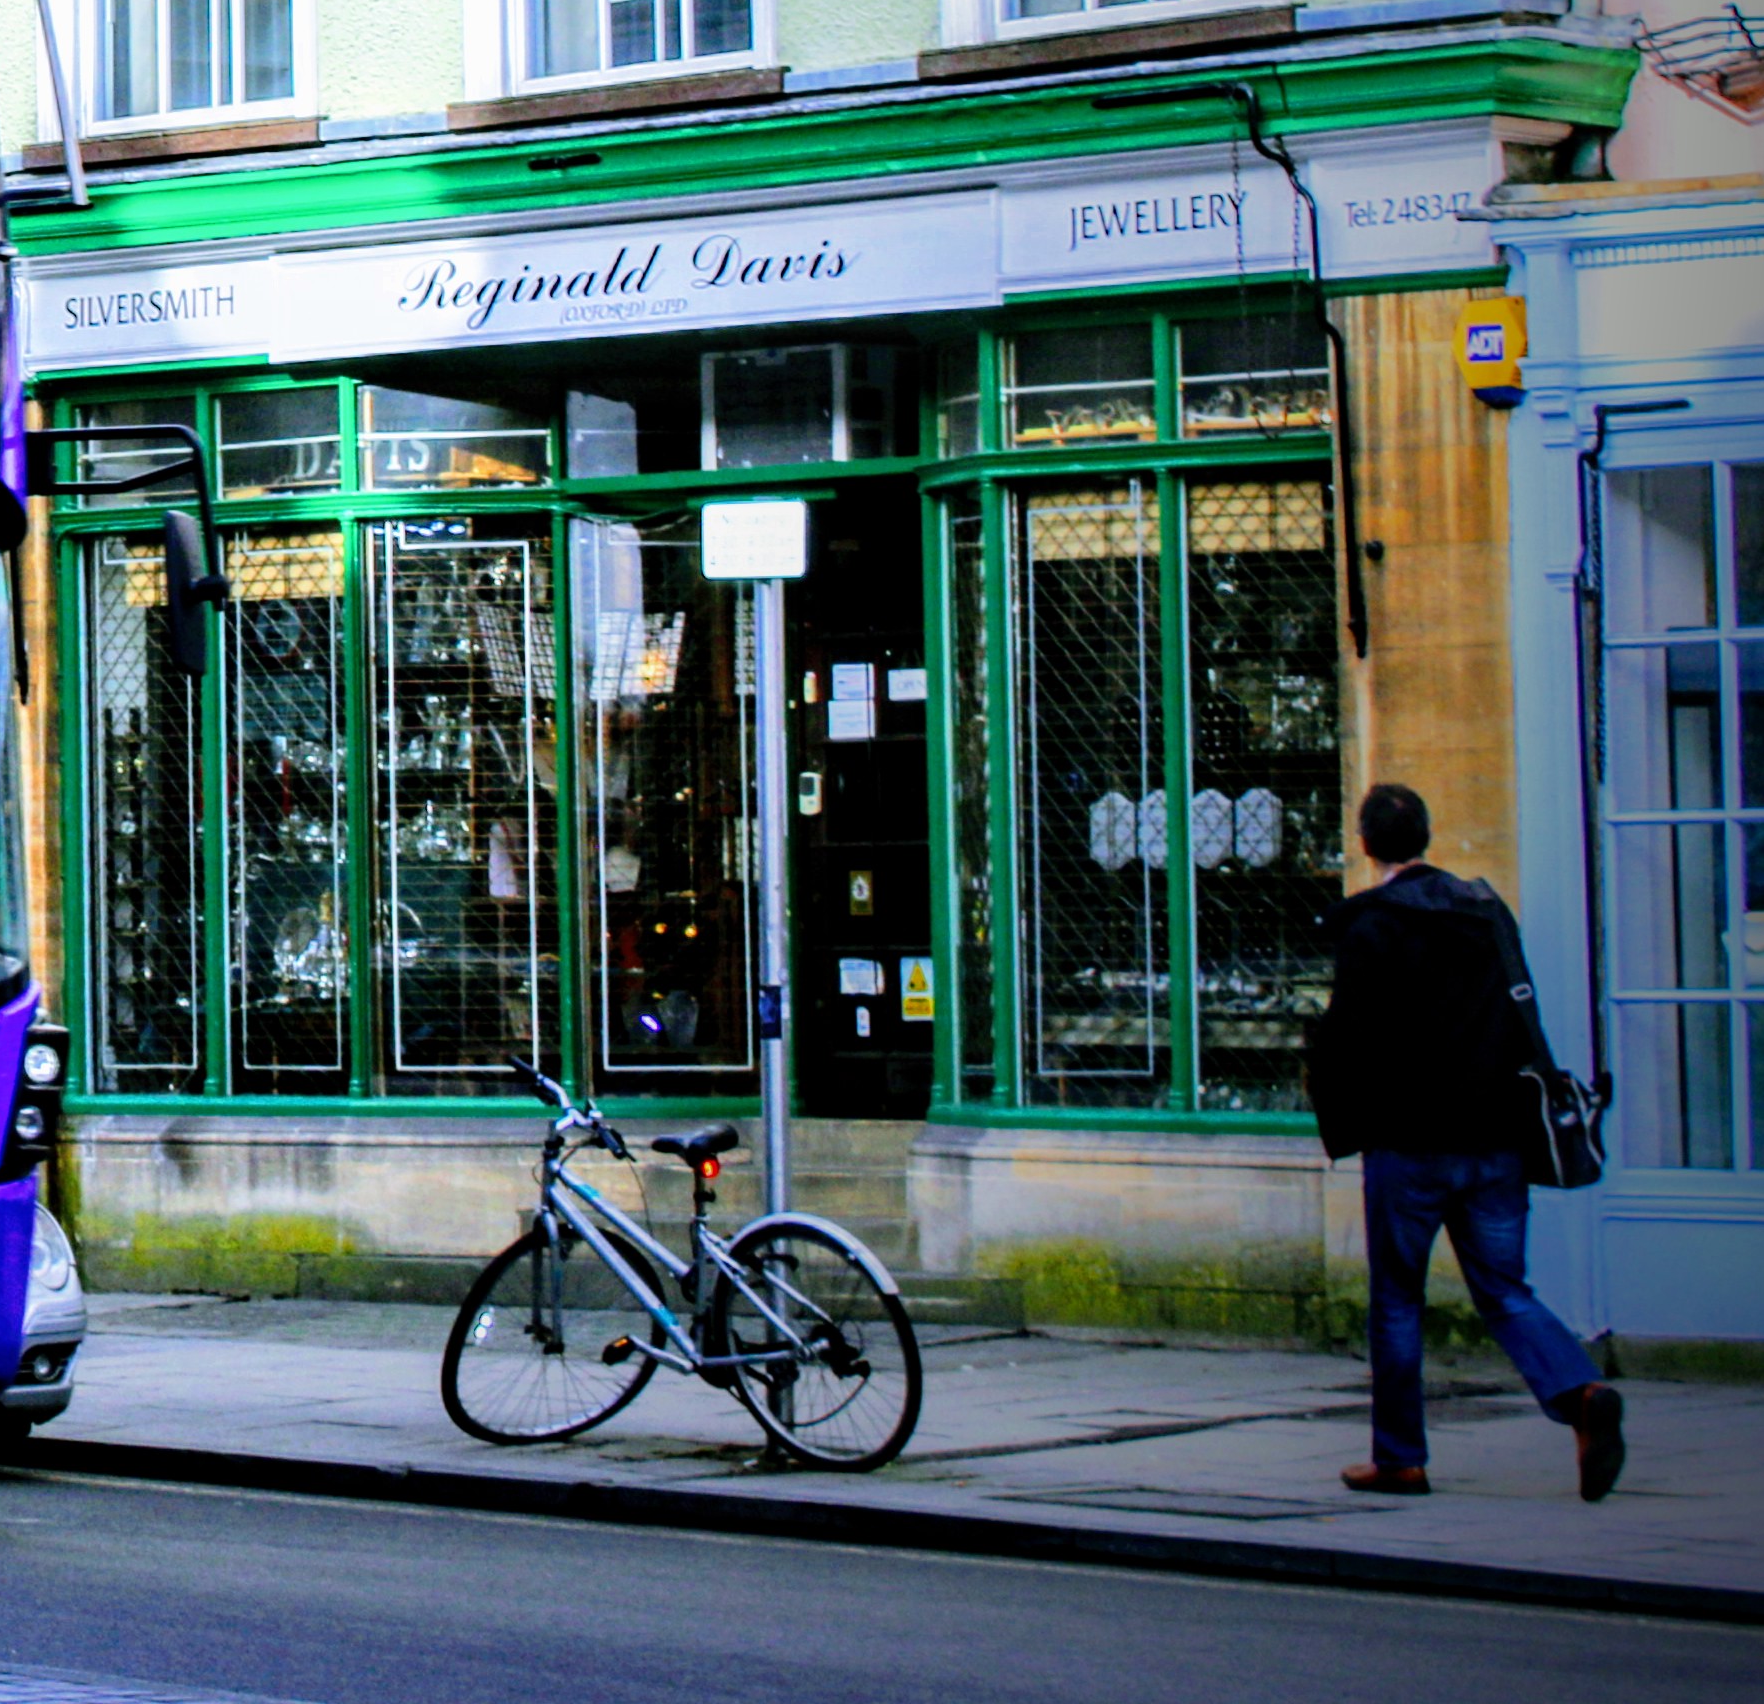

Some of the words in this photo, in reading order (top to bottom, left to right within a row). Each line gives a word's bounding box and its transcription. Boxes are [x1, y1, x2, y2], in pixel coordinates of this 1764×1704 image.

[1069, 190, 1249, 252] JEWELLERY
[1382, 191, 1472, 224] 248347
[398, 242, 666, 331] Reginald
[691, 233, 862, 291] Davis
[64, 285, 234, 330] SILVERSMITH
[1467, 329, 1503, 358] ADT
